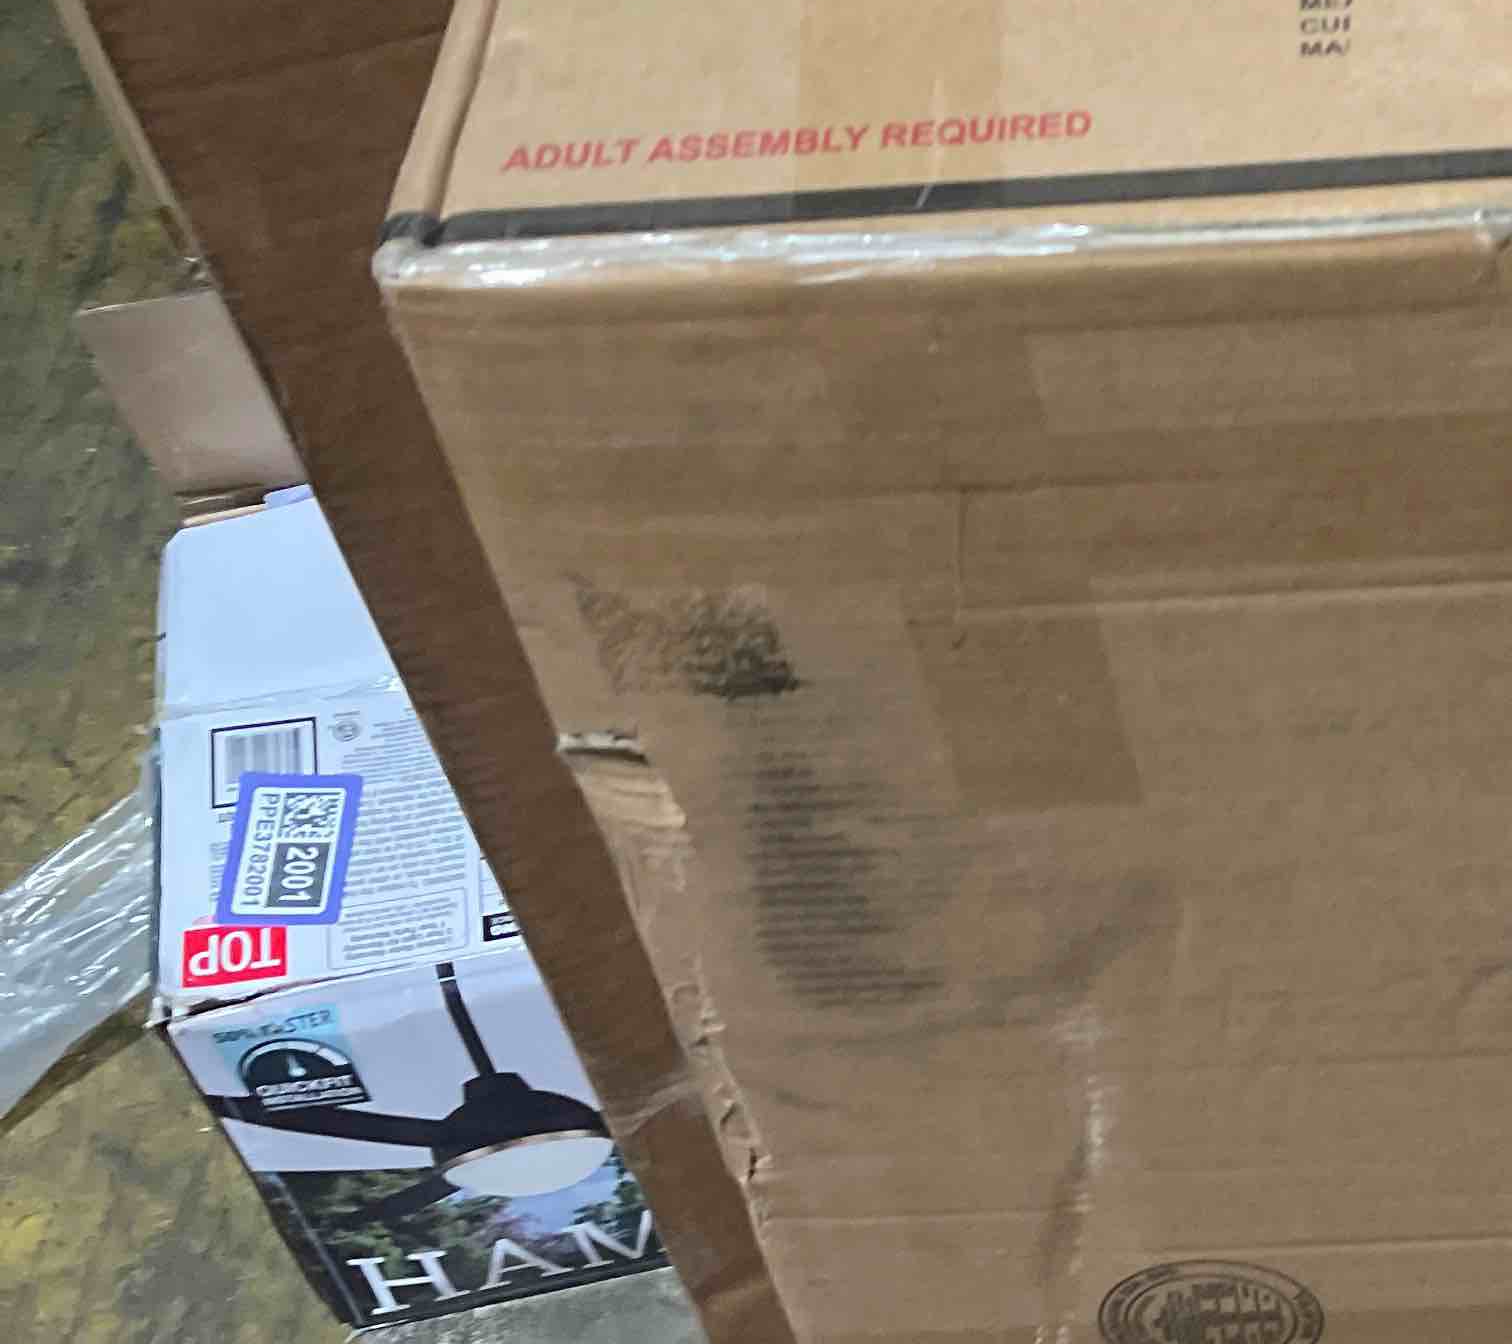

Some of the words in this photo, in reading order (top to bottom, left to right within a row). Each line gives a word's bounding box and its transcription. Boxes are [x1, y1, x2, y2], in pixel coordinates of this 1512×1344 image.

[502, 140, 639, 172] ADULT
[645, 124, 869, 163] ASSEMBLY
[880, 110, 1093, 149] REQUIRED
[239, 792, 281, 905] PPE3782001
[278, 846, 320, 902] 2001
[188, 927, 281, 977] TOP
